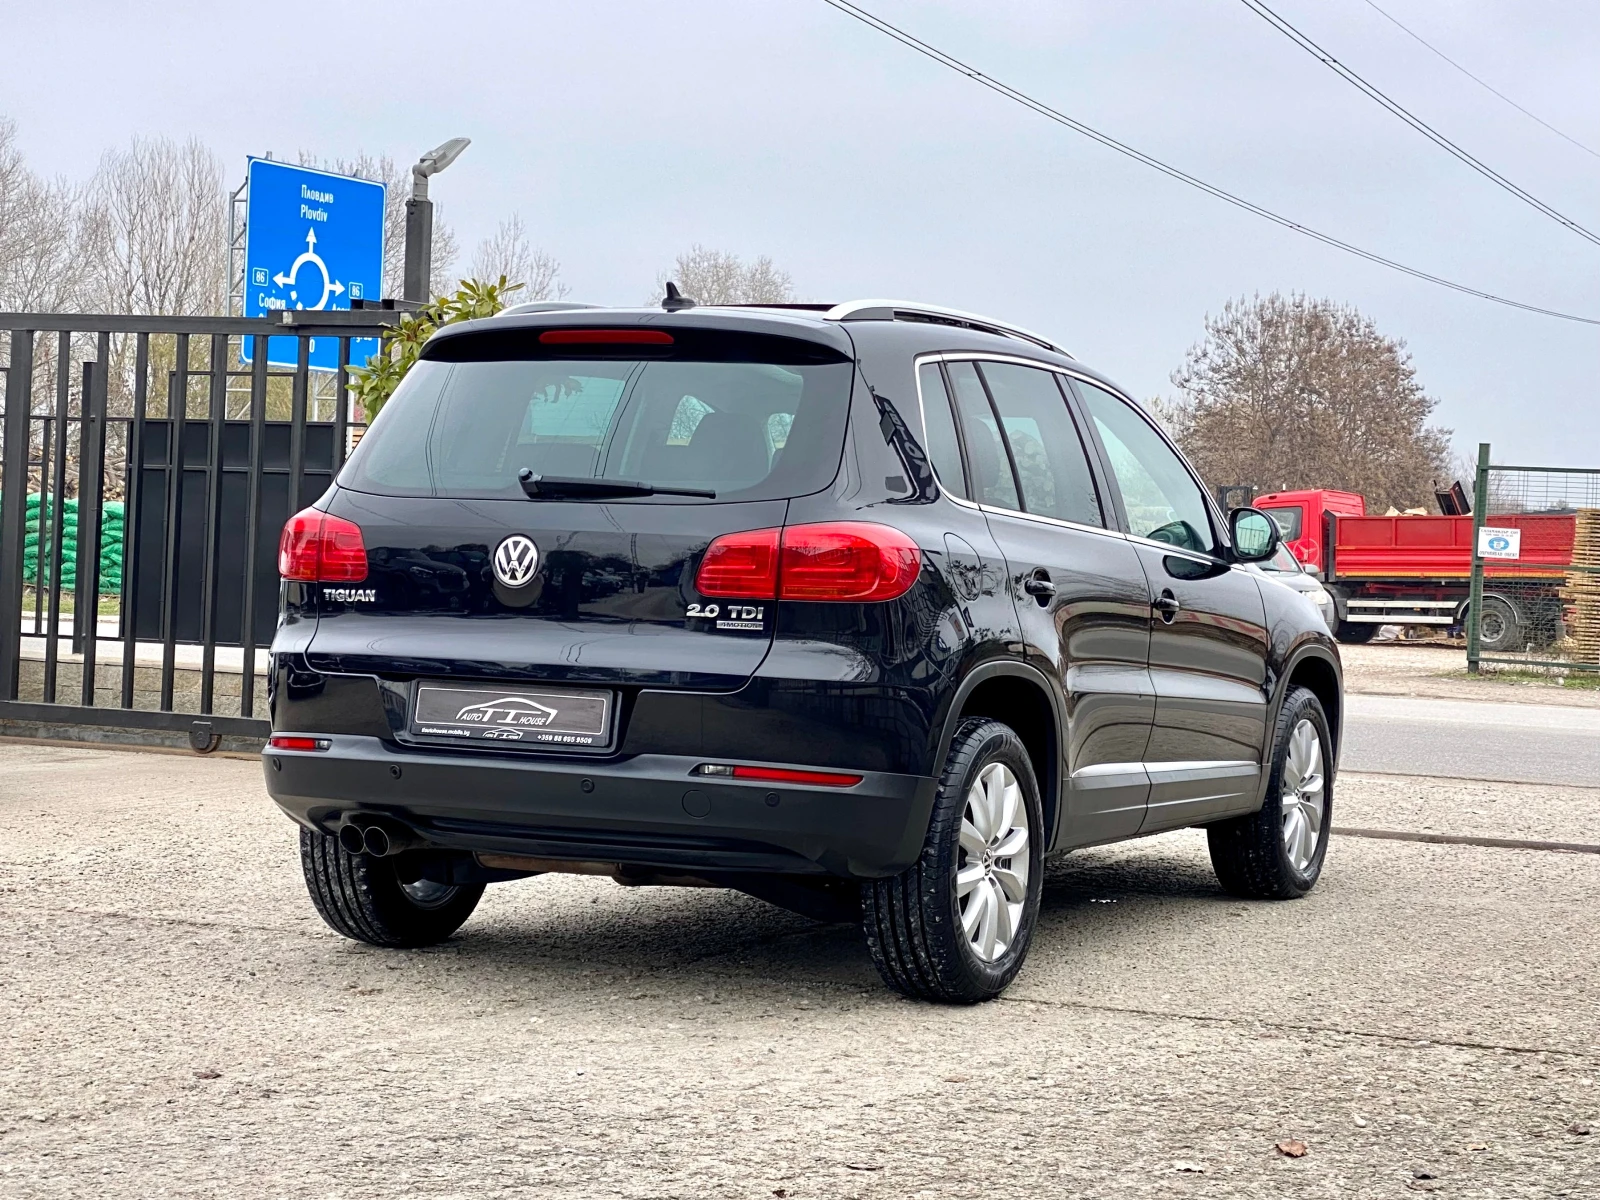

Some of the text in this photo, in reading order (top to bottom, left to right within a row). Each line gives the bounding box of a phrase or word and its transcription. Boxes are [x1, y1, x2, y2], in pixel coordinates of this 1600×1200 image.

[301, 184, 334, 204] Пловдив
[300, 203, 328, 222] Plovdiv
[255, 271, 266, 283] 86
[351, 285, 361, 297] 86
[258, 292, 286, 310] София
[494, 536, 539, 586] VW
[323, 588, 376, 602] TIGUAN
[686, 603, 764, 620] 2.0 TDI
[461, 712, 482, 721] AUTO
[518, 716, 546, 725] HOUSE
